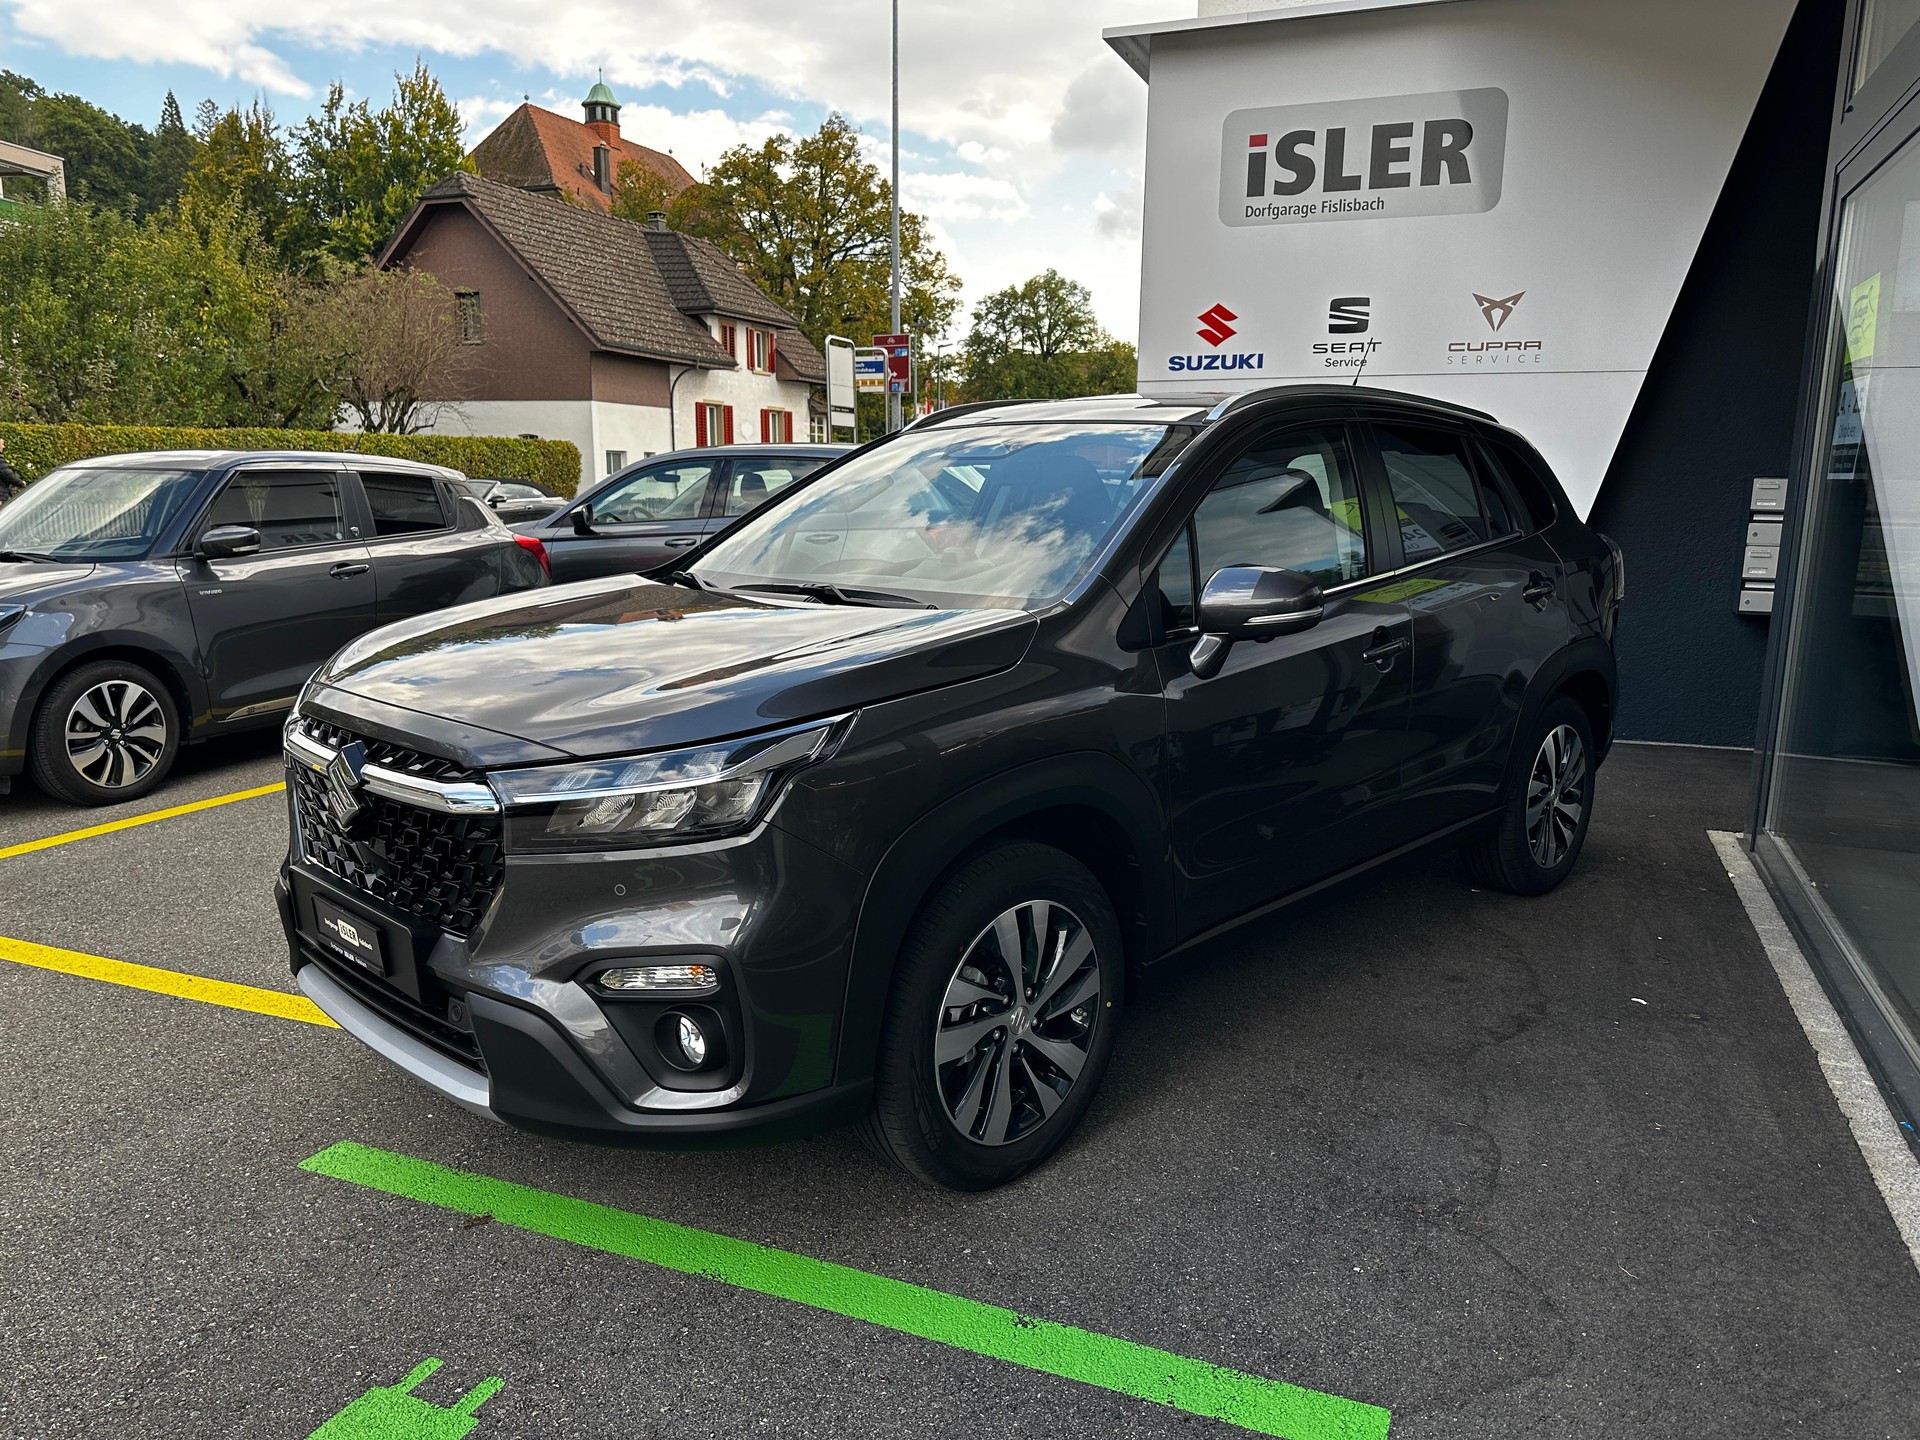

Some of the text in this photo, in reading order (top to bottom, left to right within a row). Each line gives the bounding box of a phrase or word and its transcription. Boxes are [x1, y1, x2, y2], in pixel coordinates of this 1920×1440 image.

[1245, 196, 1385, 220] Dorfgarage Fislisbach
[1312, 341, 1382, 354] SEAT
[1448, 340, 1542, 352] CUPRA
[1168, 353, 1264, 372] SUZUKI
[1324, 356, 1368, 367] Service
[1447, 354, 1541, 365] SERVICE
